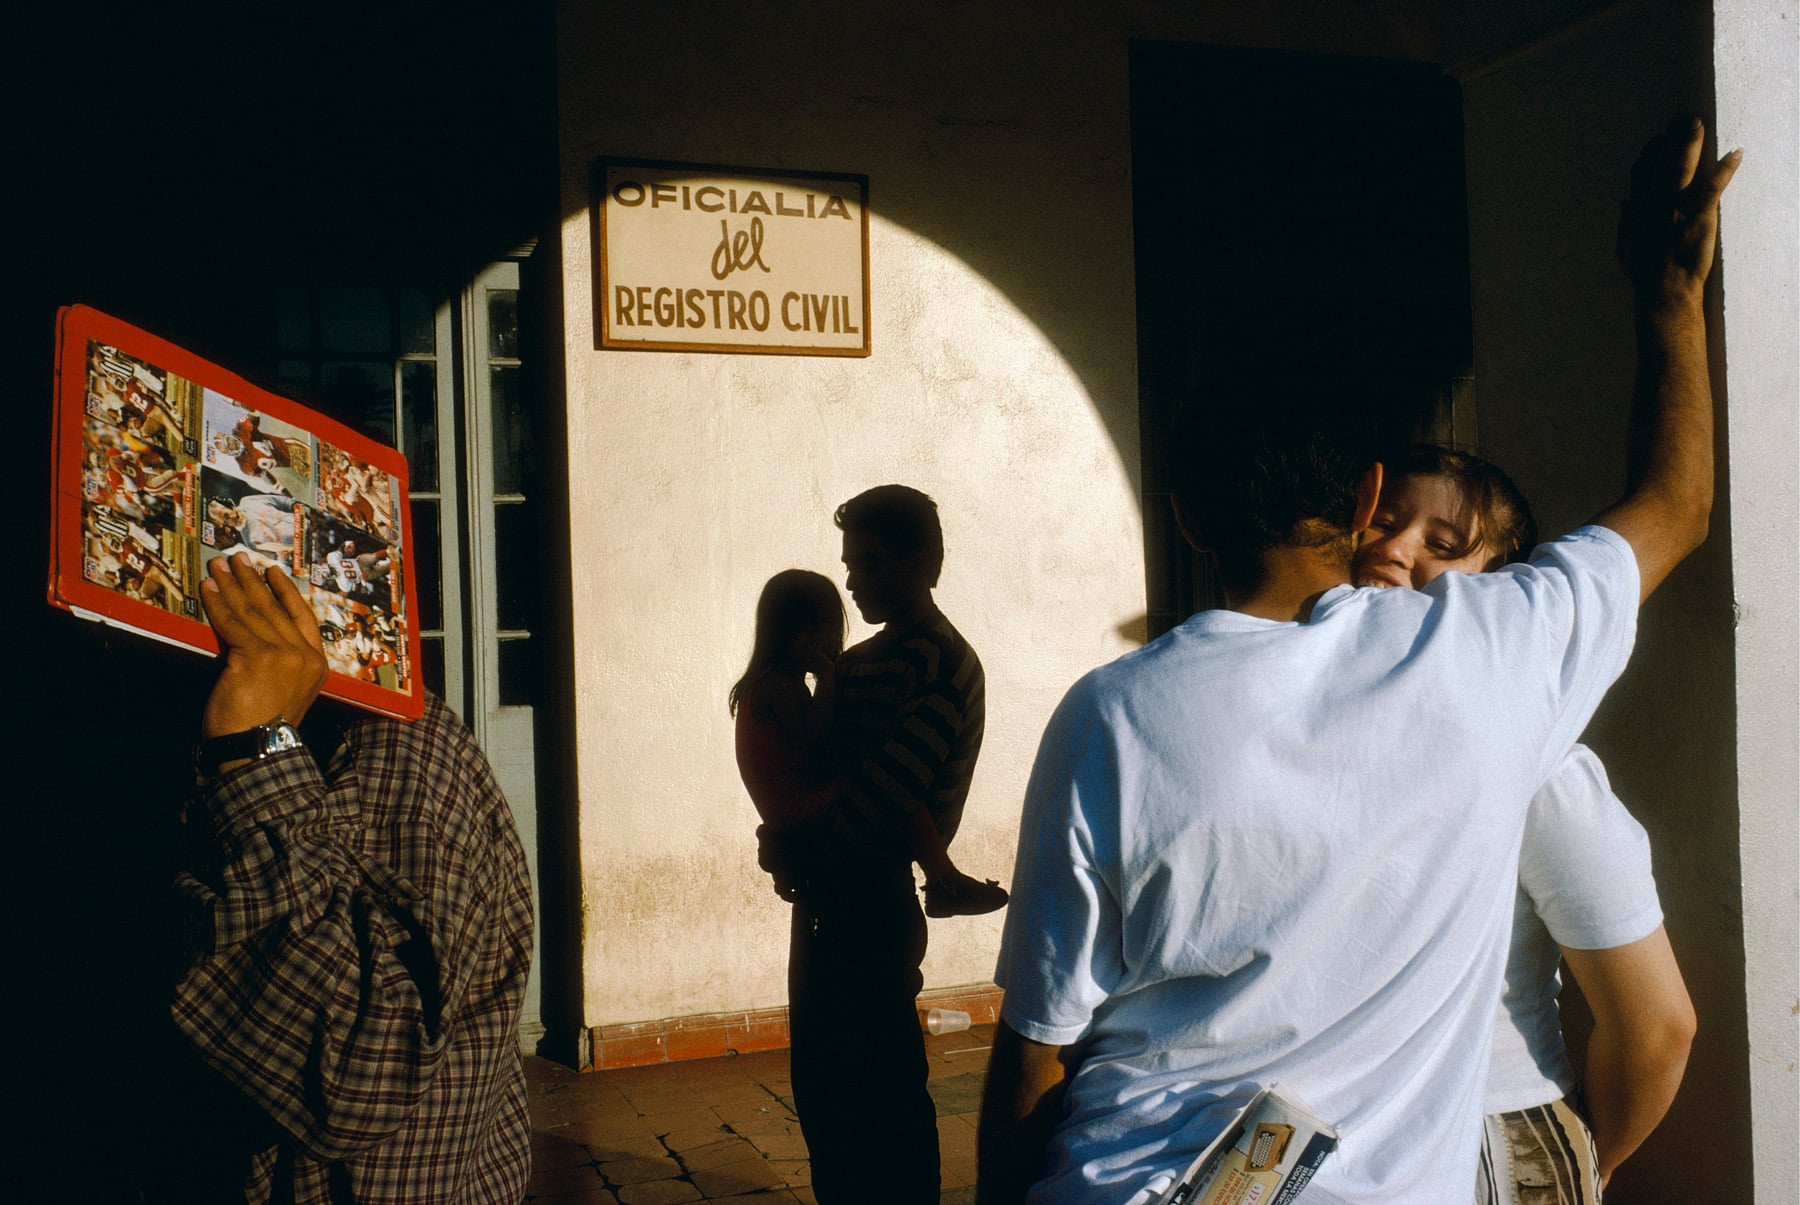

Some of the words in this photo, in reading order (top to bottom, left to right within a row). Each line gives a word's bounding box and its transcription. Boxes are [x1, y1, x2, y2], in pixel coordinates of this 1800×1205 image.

[612, 181, 854, 220] OFICIALIA
[711, 217, 771, 281] del
[615, 285, 770, 332] REGISTRO
[781, 291, 859, 334] CIVIL
[252, 440, 277, 471] 94
[339, 559, 358, 580] 80
